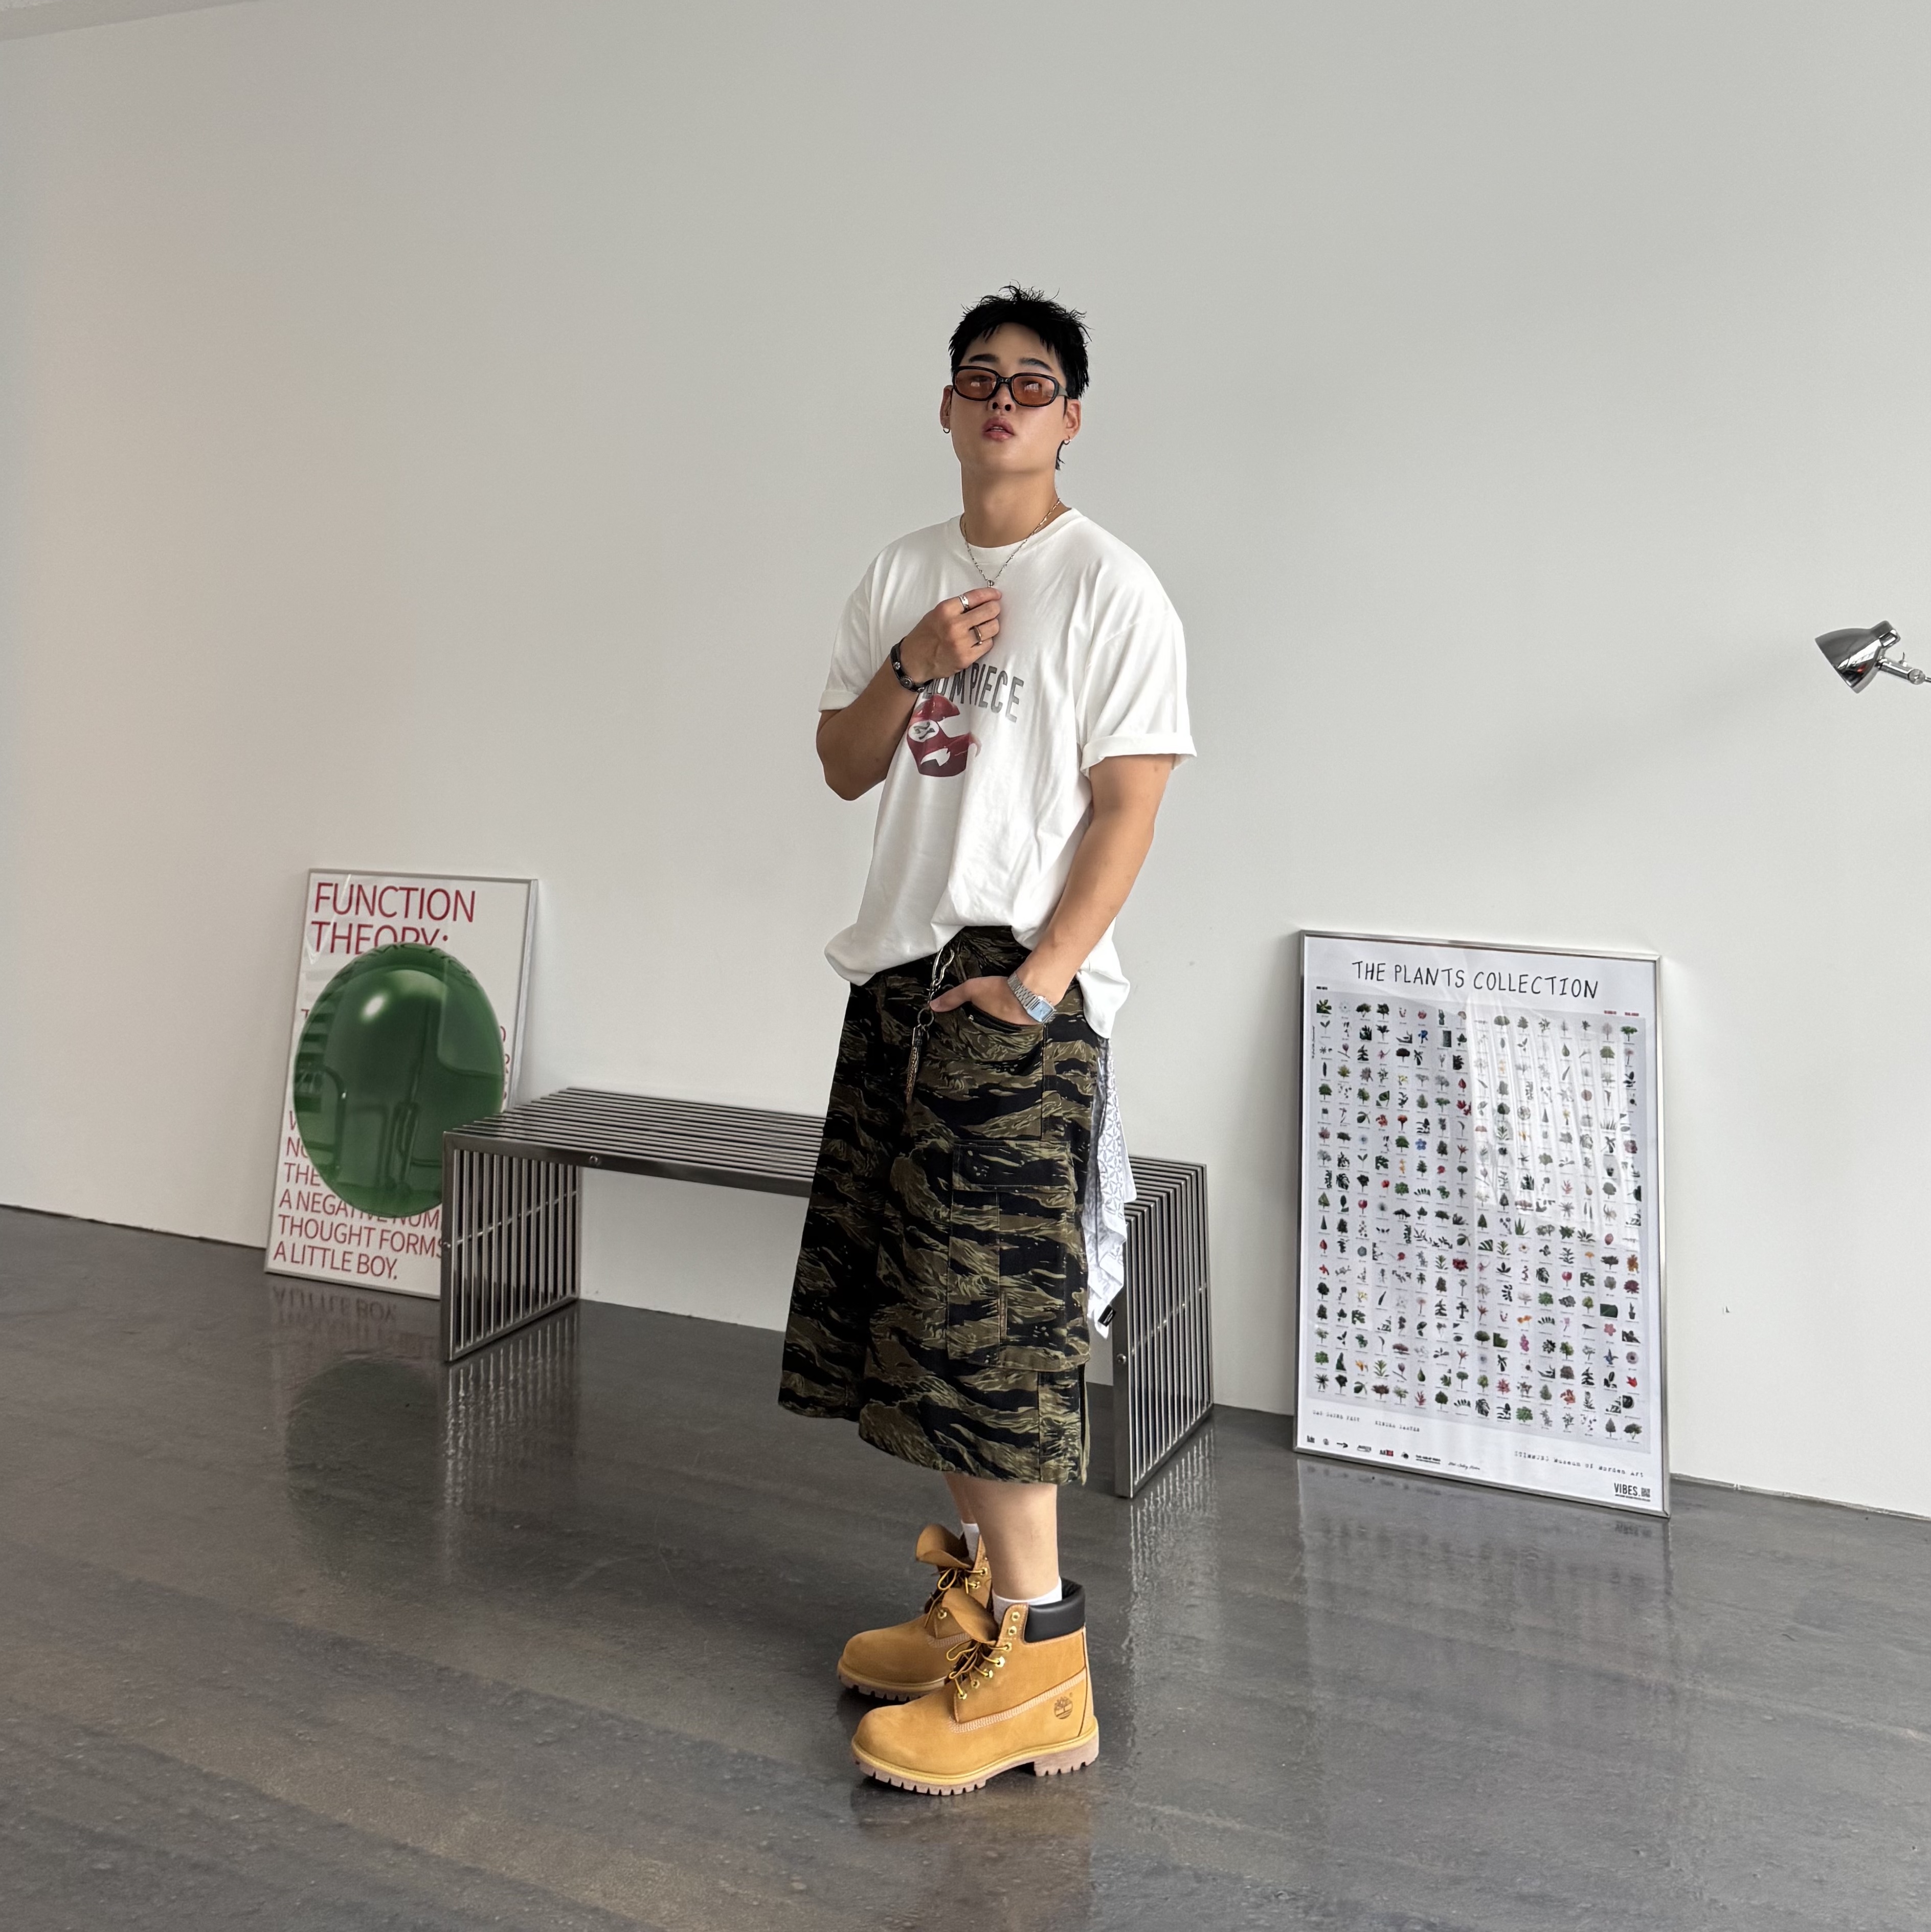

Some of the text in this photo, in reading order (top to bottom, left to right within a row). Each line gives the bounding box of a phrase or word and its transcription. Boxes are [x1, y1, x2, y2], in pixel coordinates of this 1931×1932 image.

[315, 882, 475, 923] FUNCTION
[1352, 961, 1598, 999] THE PLANTS COLLECTION
[279, 1189, 292, 1209] A
[278, 1214, 376, 1248] THOUGHT
[273, 1241, 398, 1280] A LITTLE BOY.
